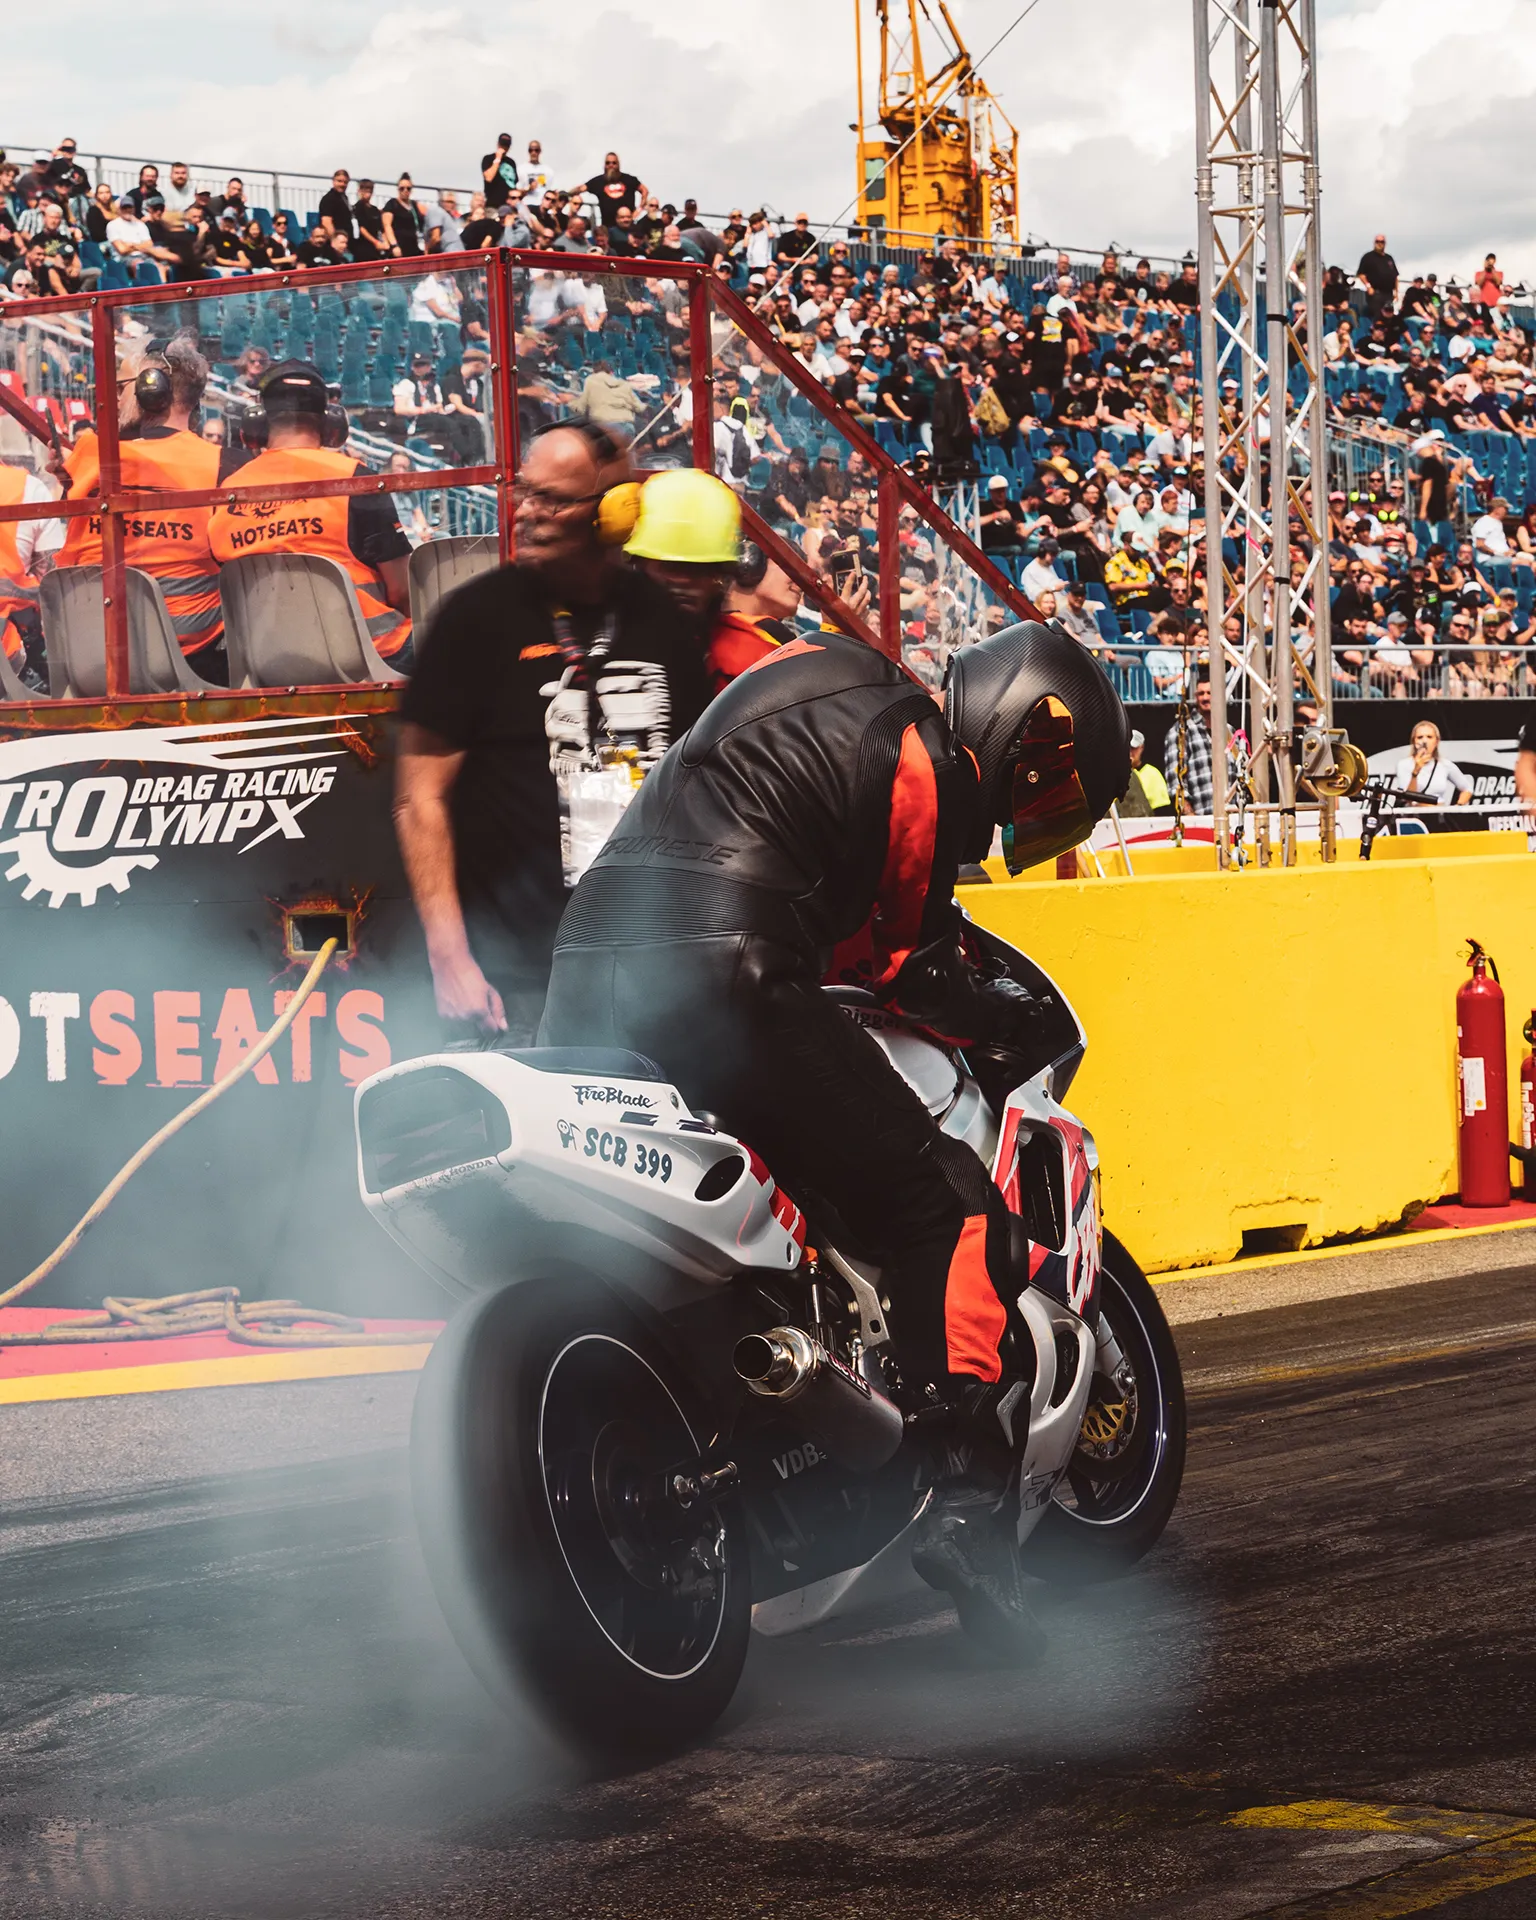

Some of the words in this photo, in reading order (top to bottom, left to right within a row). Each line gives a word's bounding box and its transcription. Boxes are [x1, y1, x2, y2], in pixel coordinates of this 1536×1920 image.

[89, 517, 193, 541] HTSEATS
[231, 517, 324, 549] HOTSEATS
[128, 773, 217, 805] DRAG
[222, 766, 337, 799] RACING
[1474, 776, 1517, 797] DRAG
[571, 1085, 661, 1109] FireBlade
[583, 1127, 628, 1168] SCB
[634, 1144, 673, 1184] 399
[450, 1160, 493, 1177] HONDA
